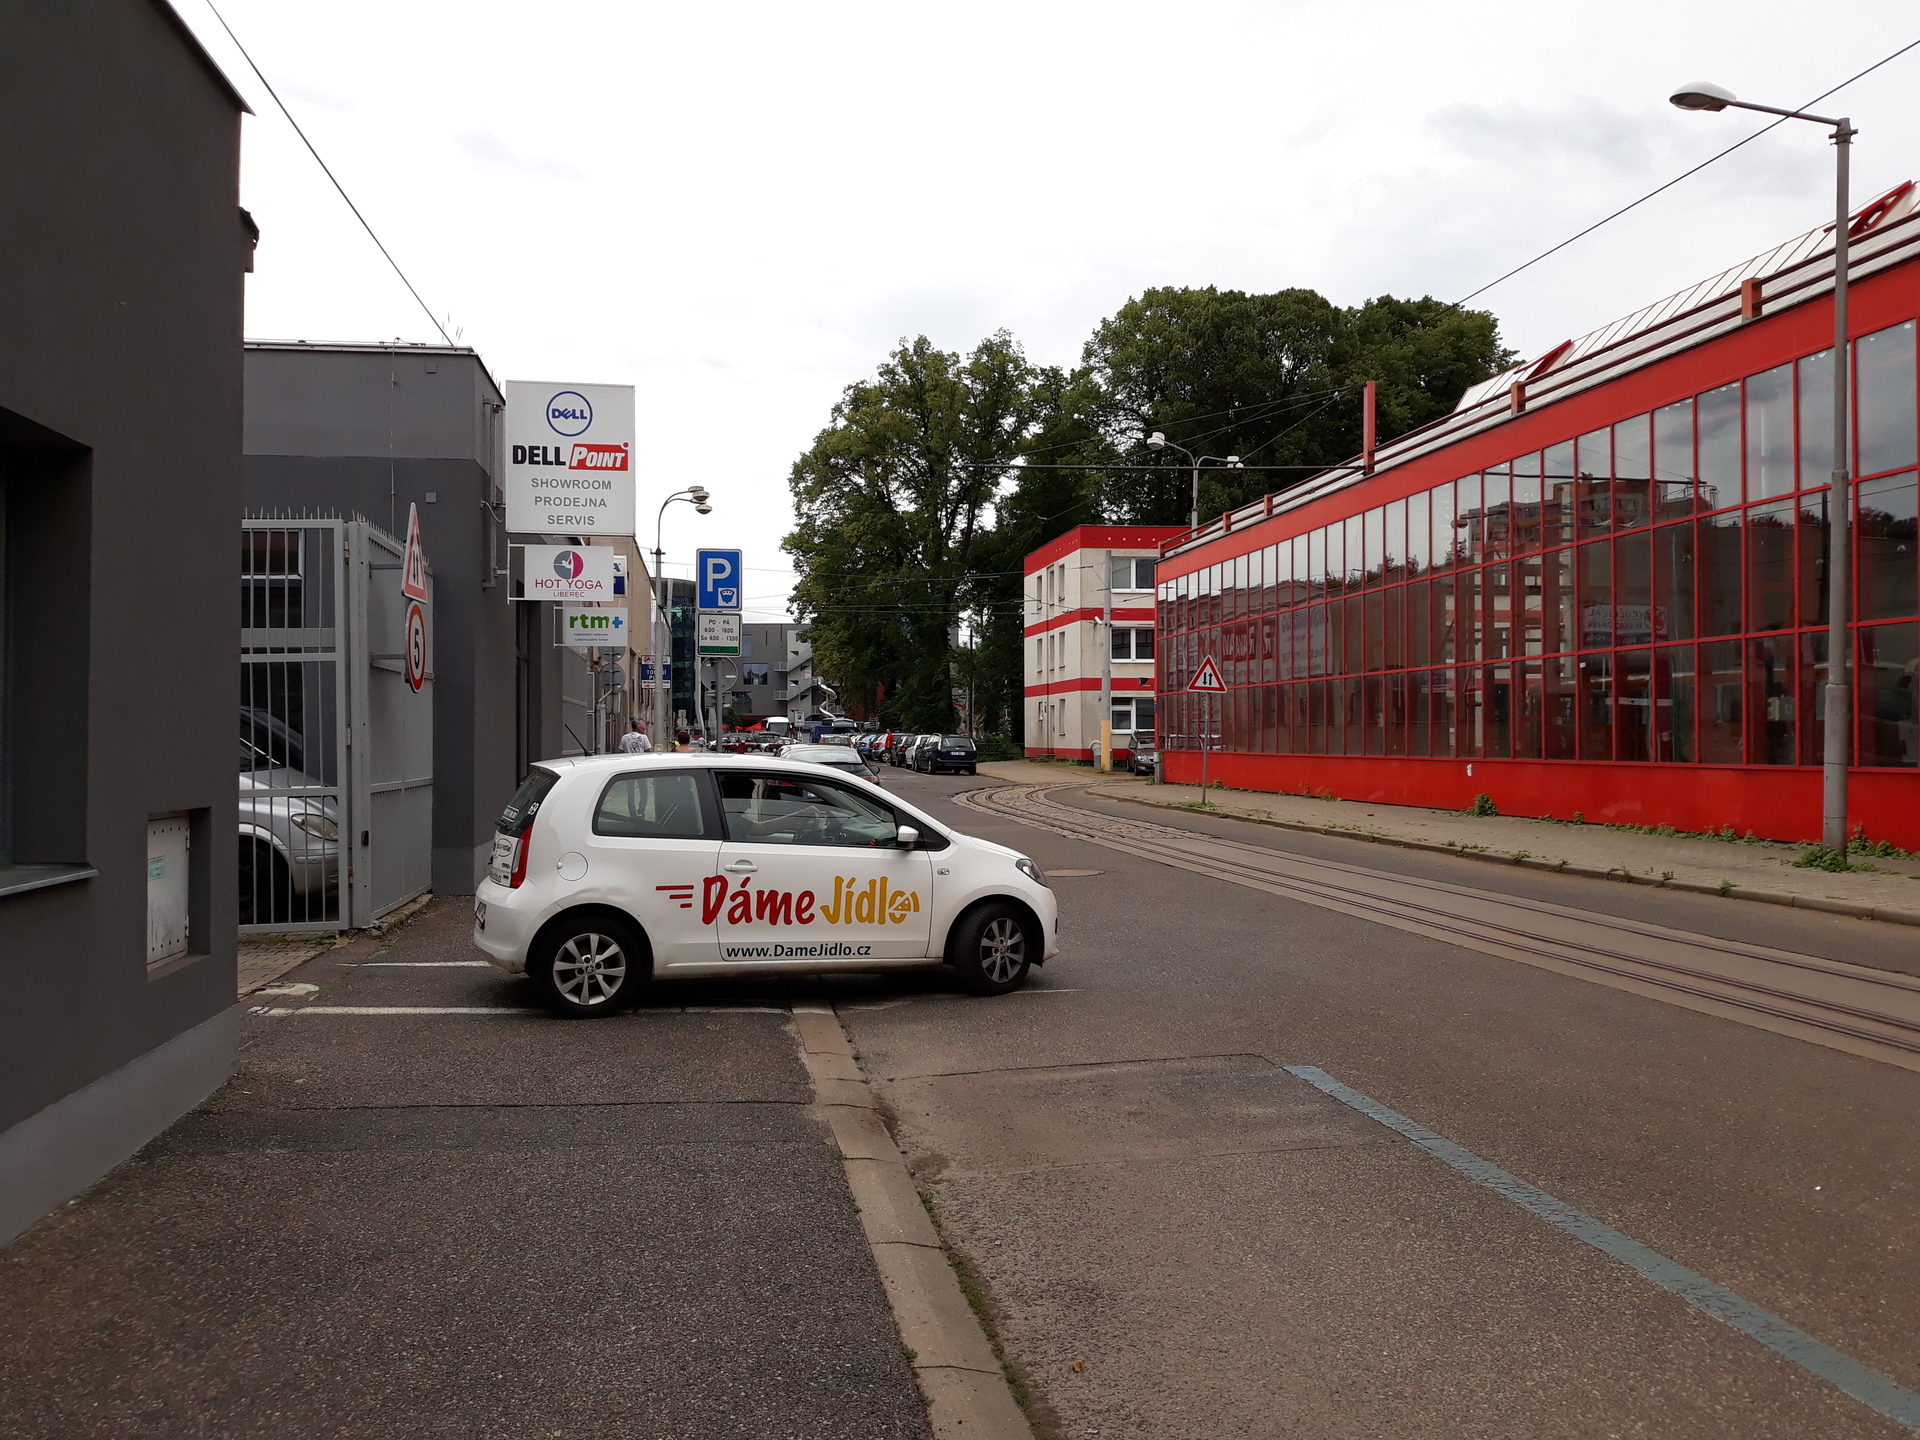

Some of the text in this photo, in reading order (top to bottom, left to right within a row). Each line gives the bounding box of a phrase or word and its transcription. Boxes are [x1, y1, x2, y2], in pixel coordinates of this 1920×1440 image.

[551, 408, 588, 420] DELL
[512, 444, 566, 466] DELL
[531, 477, 612, 490] SHOWROOM
[534, 496, 607, 508] PRODEJNA
[547, 514, 595, 526] SERVIS
[707, 557, 732, 592] P
[535, 579, 603, 590] HOT YOGA
[414, 628, 420, 669] 5
[702, 874, 918, 926] Dáme Jídlo
[726, 942, 872, 958] www.DameJidlo.cz
